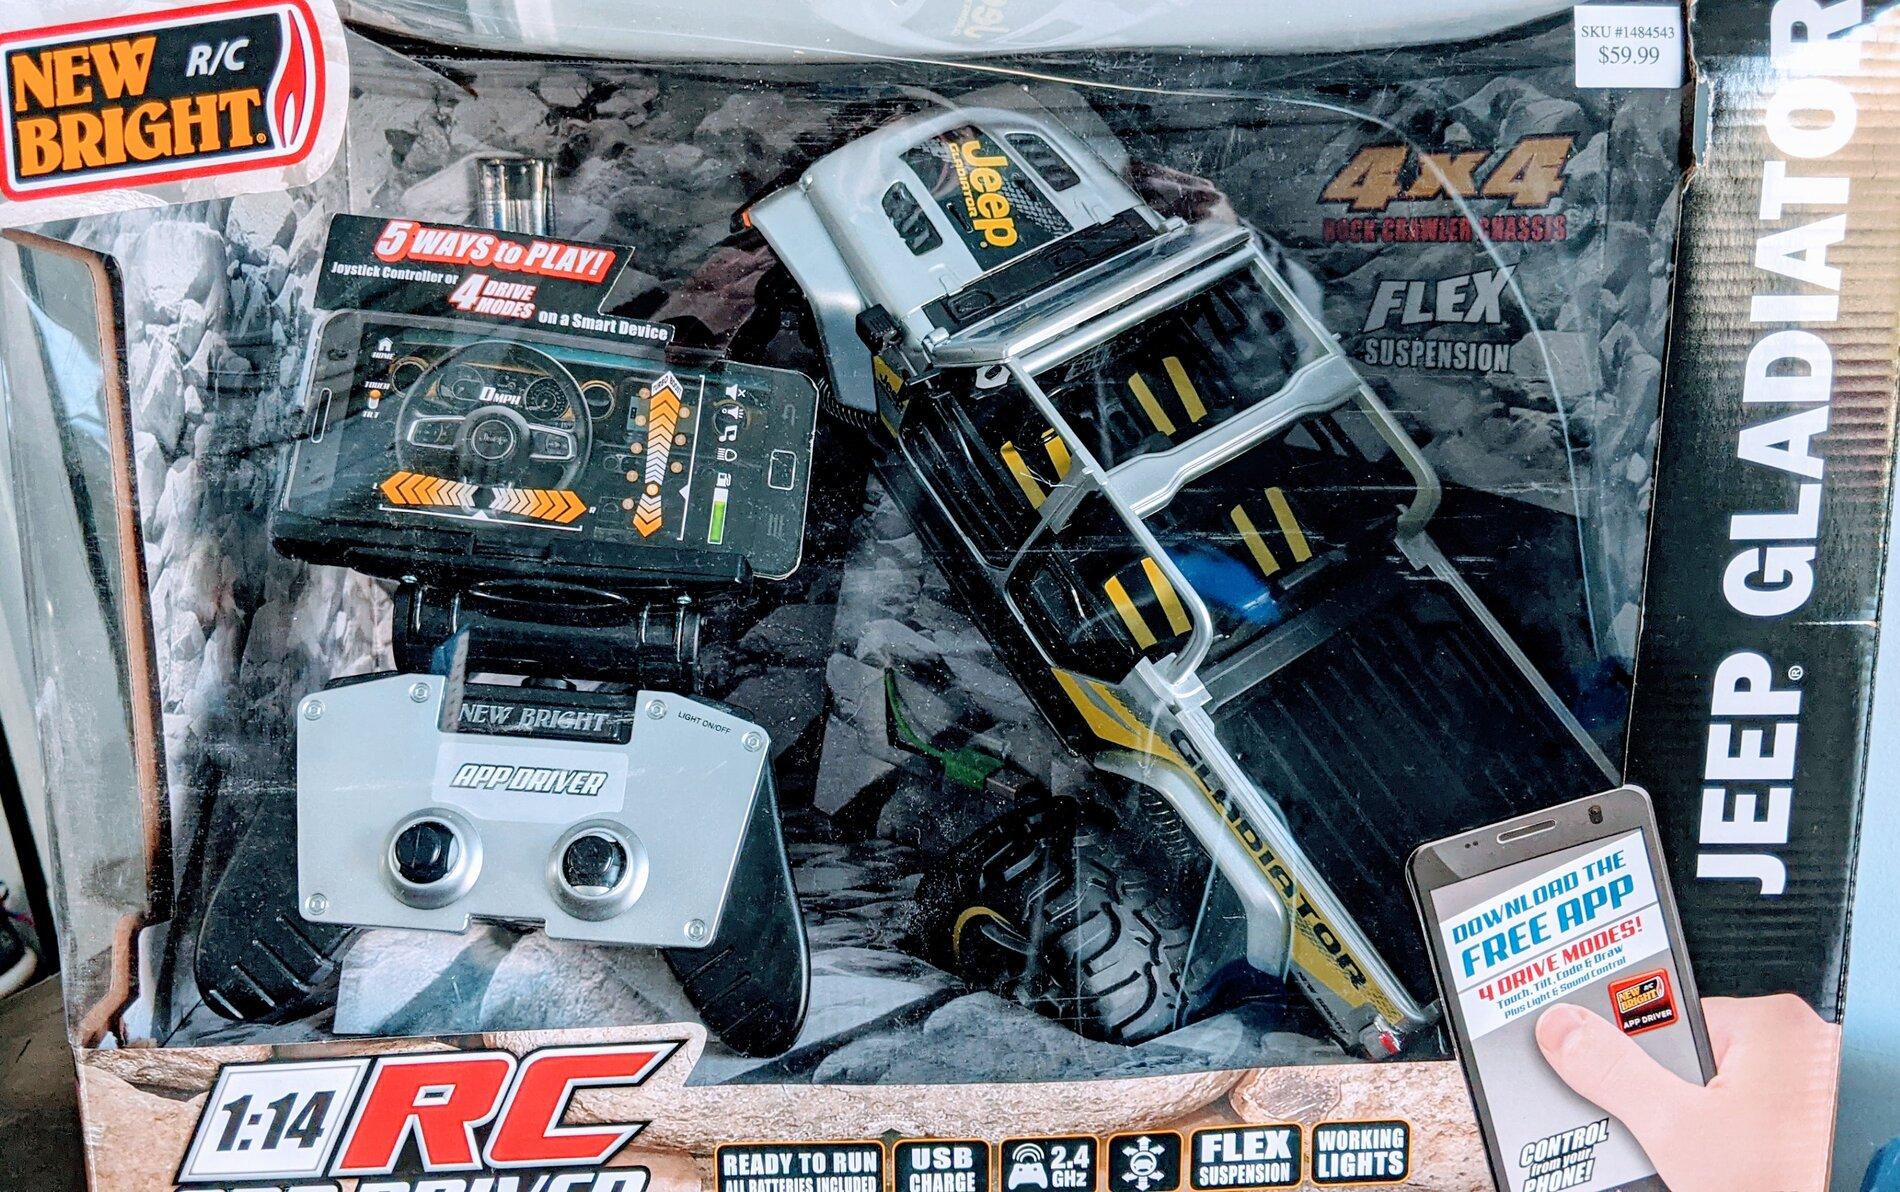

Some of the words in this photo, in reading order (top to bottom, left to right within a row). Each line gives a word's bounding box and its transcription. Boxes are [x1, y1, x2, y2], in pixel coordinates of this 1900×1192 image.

[1581, 25, 1611, 38] SKU
[1615, 25, 1675, 39] #1484543
[1598, 45, 1660, 65] $59.99
[11, 36, 157, 112] NEW
[186, 38, 250, 77] R/C
[949, 142, 978, 218] GLADIATOR
[1319, 132, 1580, 212] 4x4
[961, 140, 1018, 247] Jeep
[1322, 217, 1378, 243] ROCK
[1381, 216, 1473, 243] CRAWLER
[1477, 214, 1567, 242] CHASSIS
[377, 221, 413, 256] 5
[409, 228, 494, 260] WAYS
[493, 240, 520, 265] to
[524, 241, 607, 276] PLAY!
[331, 261, 380, 278] Joystick
[382, 266, 444, 283] Controller
[445, 275, 459, 285] or
[450, 273, 488, 309] 4
[485, 279, 537, 301] DRIVE
[1362, 263, 1518, 334] FLEX
[473, 299, 536, 319] MODES
[1723, 0, 1863, 616] GLADIATOR
[538, 311, 557, 324] on
[560, 314, 570, 326] a
[572, 315, 616, 333] Smart
[618, 321, 668, 341] Device
[1364, 337, 1511, 373] SUSPENSION
[458, 703, 513, 726] NEW
[519, 707, 609, 733] BRIGHT
[678, 711, 701, 725] LIGHT
[701, 719, 732, 735] ON/OFF
[450, 762, 513, 791] APP
[506, 767, 608, 796] DRIVER
[1170, 729, 1367, 991] GLADIATOR
[1452, 871, 1579, 945] DOWNLOAD
[1582, 849, 1626, 882] THE
[1461, 911, 1552, 979] FREE
[1556, 873, 1635, 934] APP
[1478, 985, 1494, 1002] 4
[1497, 953, 1560, 996] DRIVE
[1563, 915, 1643, 966] MODES!
[1556, 963, 1584, 984] Code
[1584, 958, 1593, 968] &
[1594, 944, 1624, 964] Draw
[1504, 1004, 1526, 1019] Plus
[1526, 990, 1552, 1012] Light
[1553, 986, 1560, 996] &
[1560, 971, 1591, 993] Sound
[1591, 956, 1627, 978] Control
[1619, 986, 1640, 1002] NEW
[1621, 989, 1658, 1011] BRIGHT
[1623, 1018, 1641, 1029] APP
[1641, 1008, 1673, 1024] DRIVER
[216, 1089, 331, 1153] 1:14
[328, 1043, 680, 1177] RC
[1201, 1130, 1291, 1163] FLEX
[1317, 1128, 1403, 1152] WORKING
[1520, 1118, 1608, 1167] CONTROL
[723, 1153, 793, 1177] READY
[798, 1152, 830, 1175] TO
[833, 1151, 878, 1174] RUN
[911, 1147, 973, 1170] USB
[1050, 1145, 1090, 1169] 2.4
[1317, 1150, 1404, 1179] LIGHTS
[1530, 1158, 1561, 1177] from
[1561, 1147, 1593, 1168] your
[725, 1179, 746, 1192] ALL
[749, 1178, 814, 1192] BATTERIES
[816, 1177, 877, 1192] INCLUDED
[909, 1172, 976, 1192] CHARGE
[1052, 1170, 1087, 1188] GHz
[1199, 1162, 1290, 1186] SUSPENSION
[1523, 1158, 1595, 1192] PHONE!
